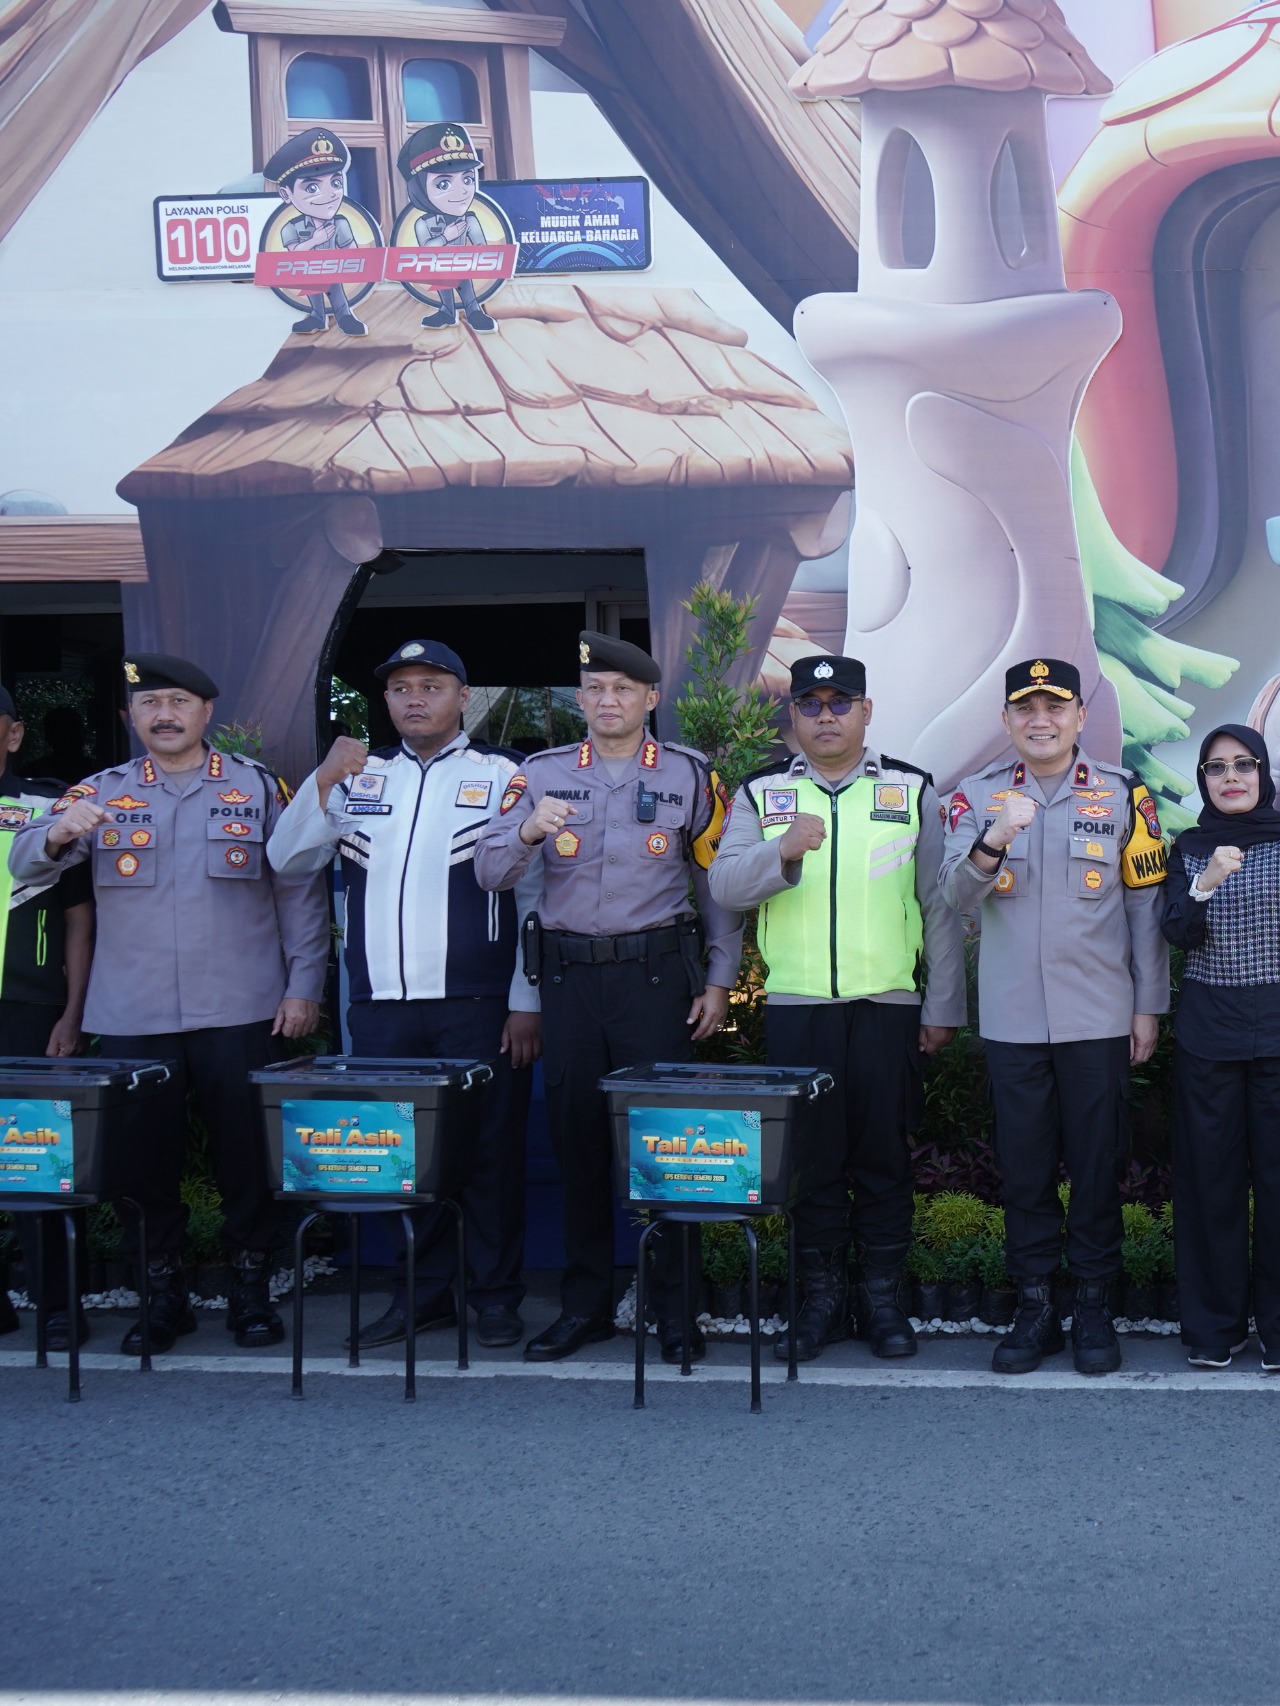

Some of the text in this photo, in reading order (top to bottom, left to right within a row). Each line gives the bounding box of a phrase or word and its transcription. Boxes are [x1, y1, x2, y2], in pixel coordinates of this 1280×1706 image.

[165, 205, 248, 216] LAYANAN POLISI
[540, 214, 619, 228] MUDIK AMAN
[170, 223, 247, 258] 110
[521, 228, 639, 244] KELUARGA BAHAGIA
[275, 258, 366, 276] PRESISI
[397, 252, 504, 273] PRESISI
[210, 807, 260, 819] POLRI
[763, 816, 787, 825] GUNTUR
[1074, 821, 1115, 835] POLRI
[4, 1127, 60, 1145] Asih
[296, 1128, 402, 1147] Tali Asih
[642, 1136, 747, 1156] Tali Asih
